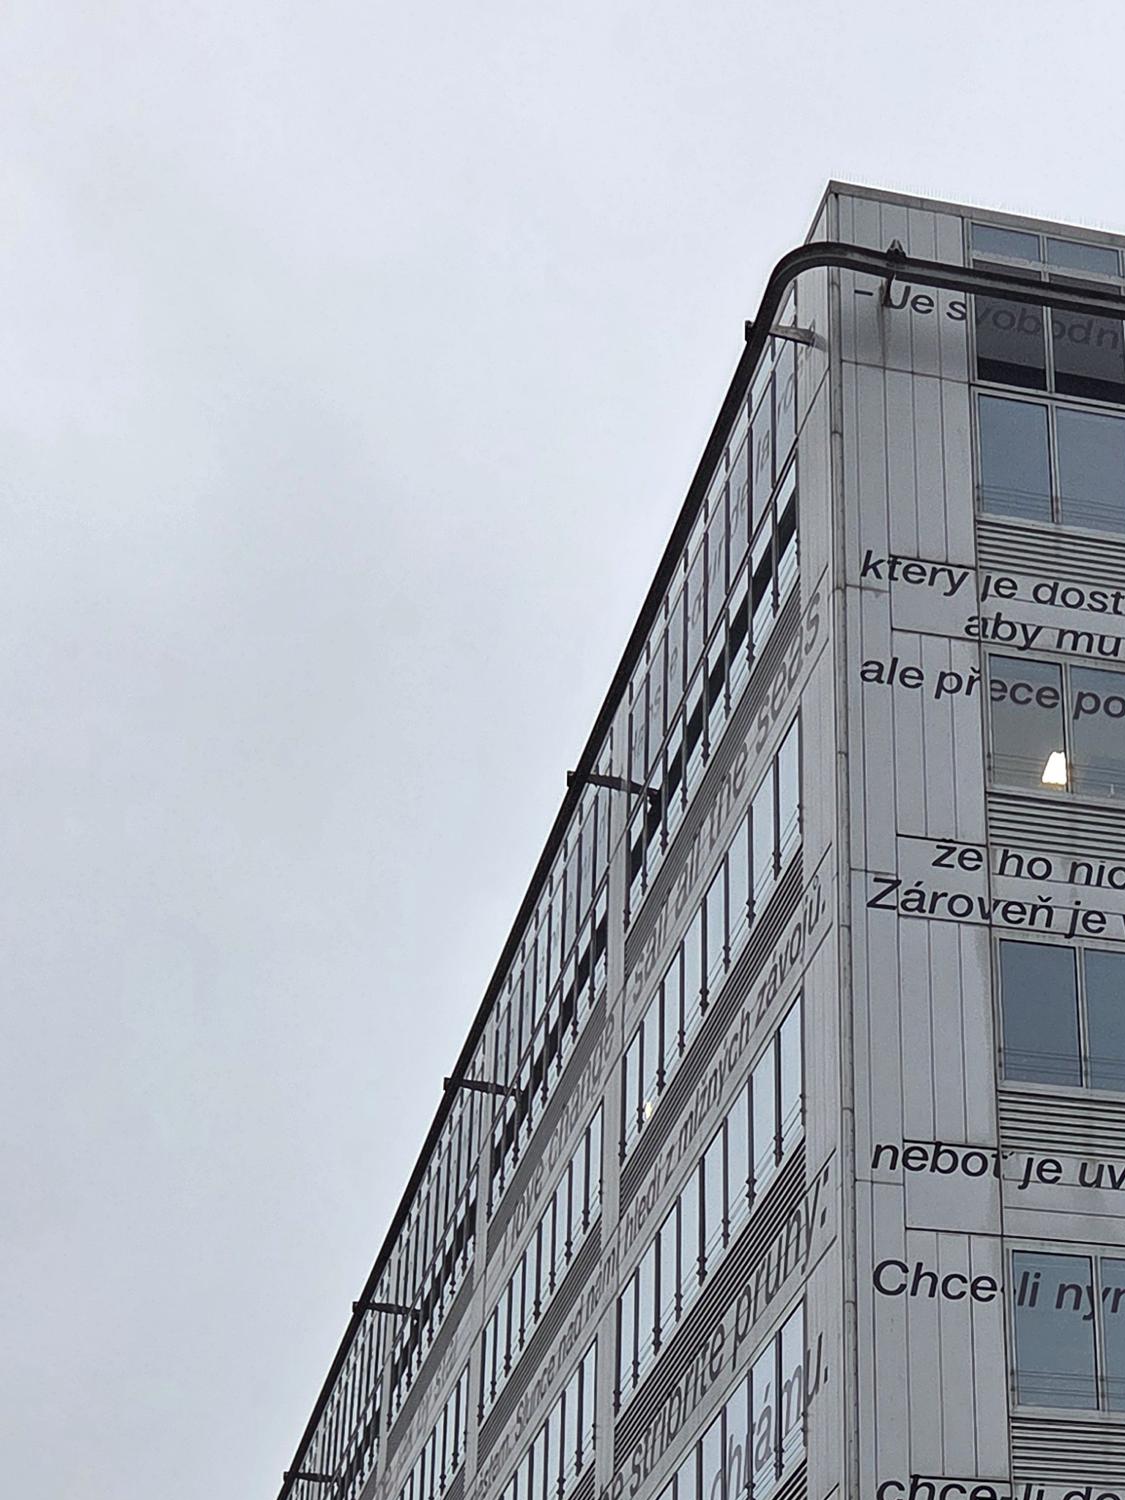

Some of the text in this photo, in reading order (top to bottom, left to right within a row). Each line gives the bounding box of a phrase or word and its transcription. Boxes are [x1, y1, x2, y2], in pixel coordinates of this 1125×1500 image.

[980, 575, 1018, 603] je
[1032, 581, 1125, 616] dost
[964, 612, 1043, 652] aby
[1055, 627, 1122, 658] mu
[756, 583, 821, 763] seas
[860, 656, 924, 690] ale
[935, 667, 1062, 708] přece
[998, 848, 1053, 882] ho
[866, 875, 1055, 929] Zároveň
[1064, 901, 1107, 939] je
[871, 1139, 1014, 1180] neboť
[1017, 1153, 1064, 1190] je
[733, 1157, 830, 1374] pruhy:
